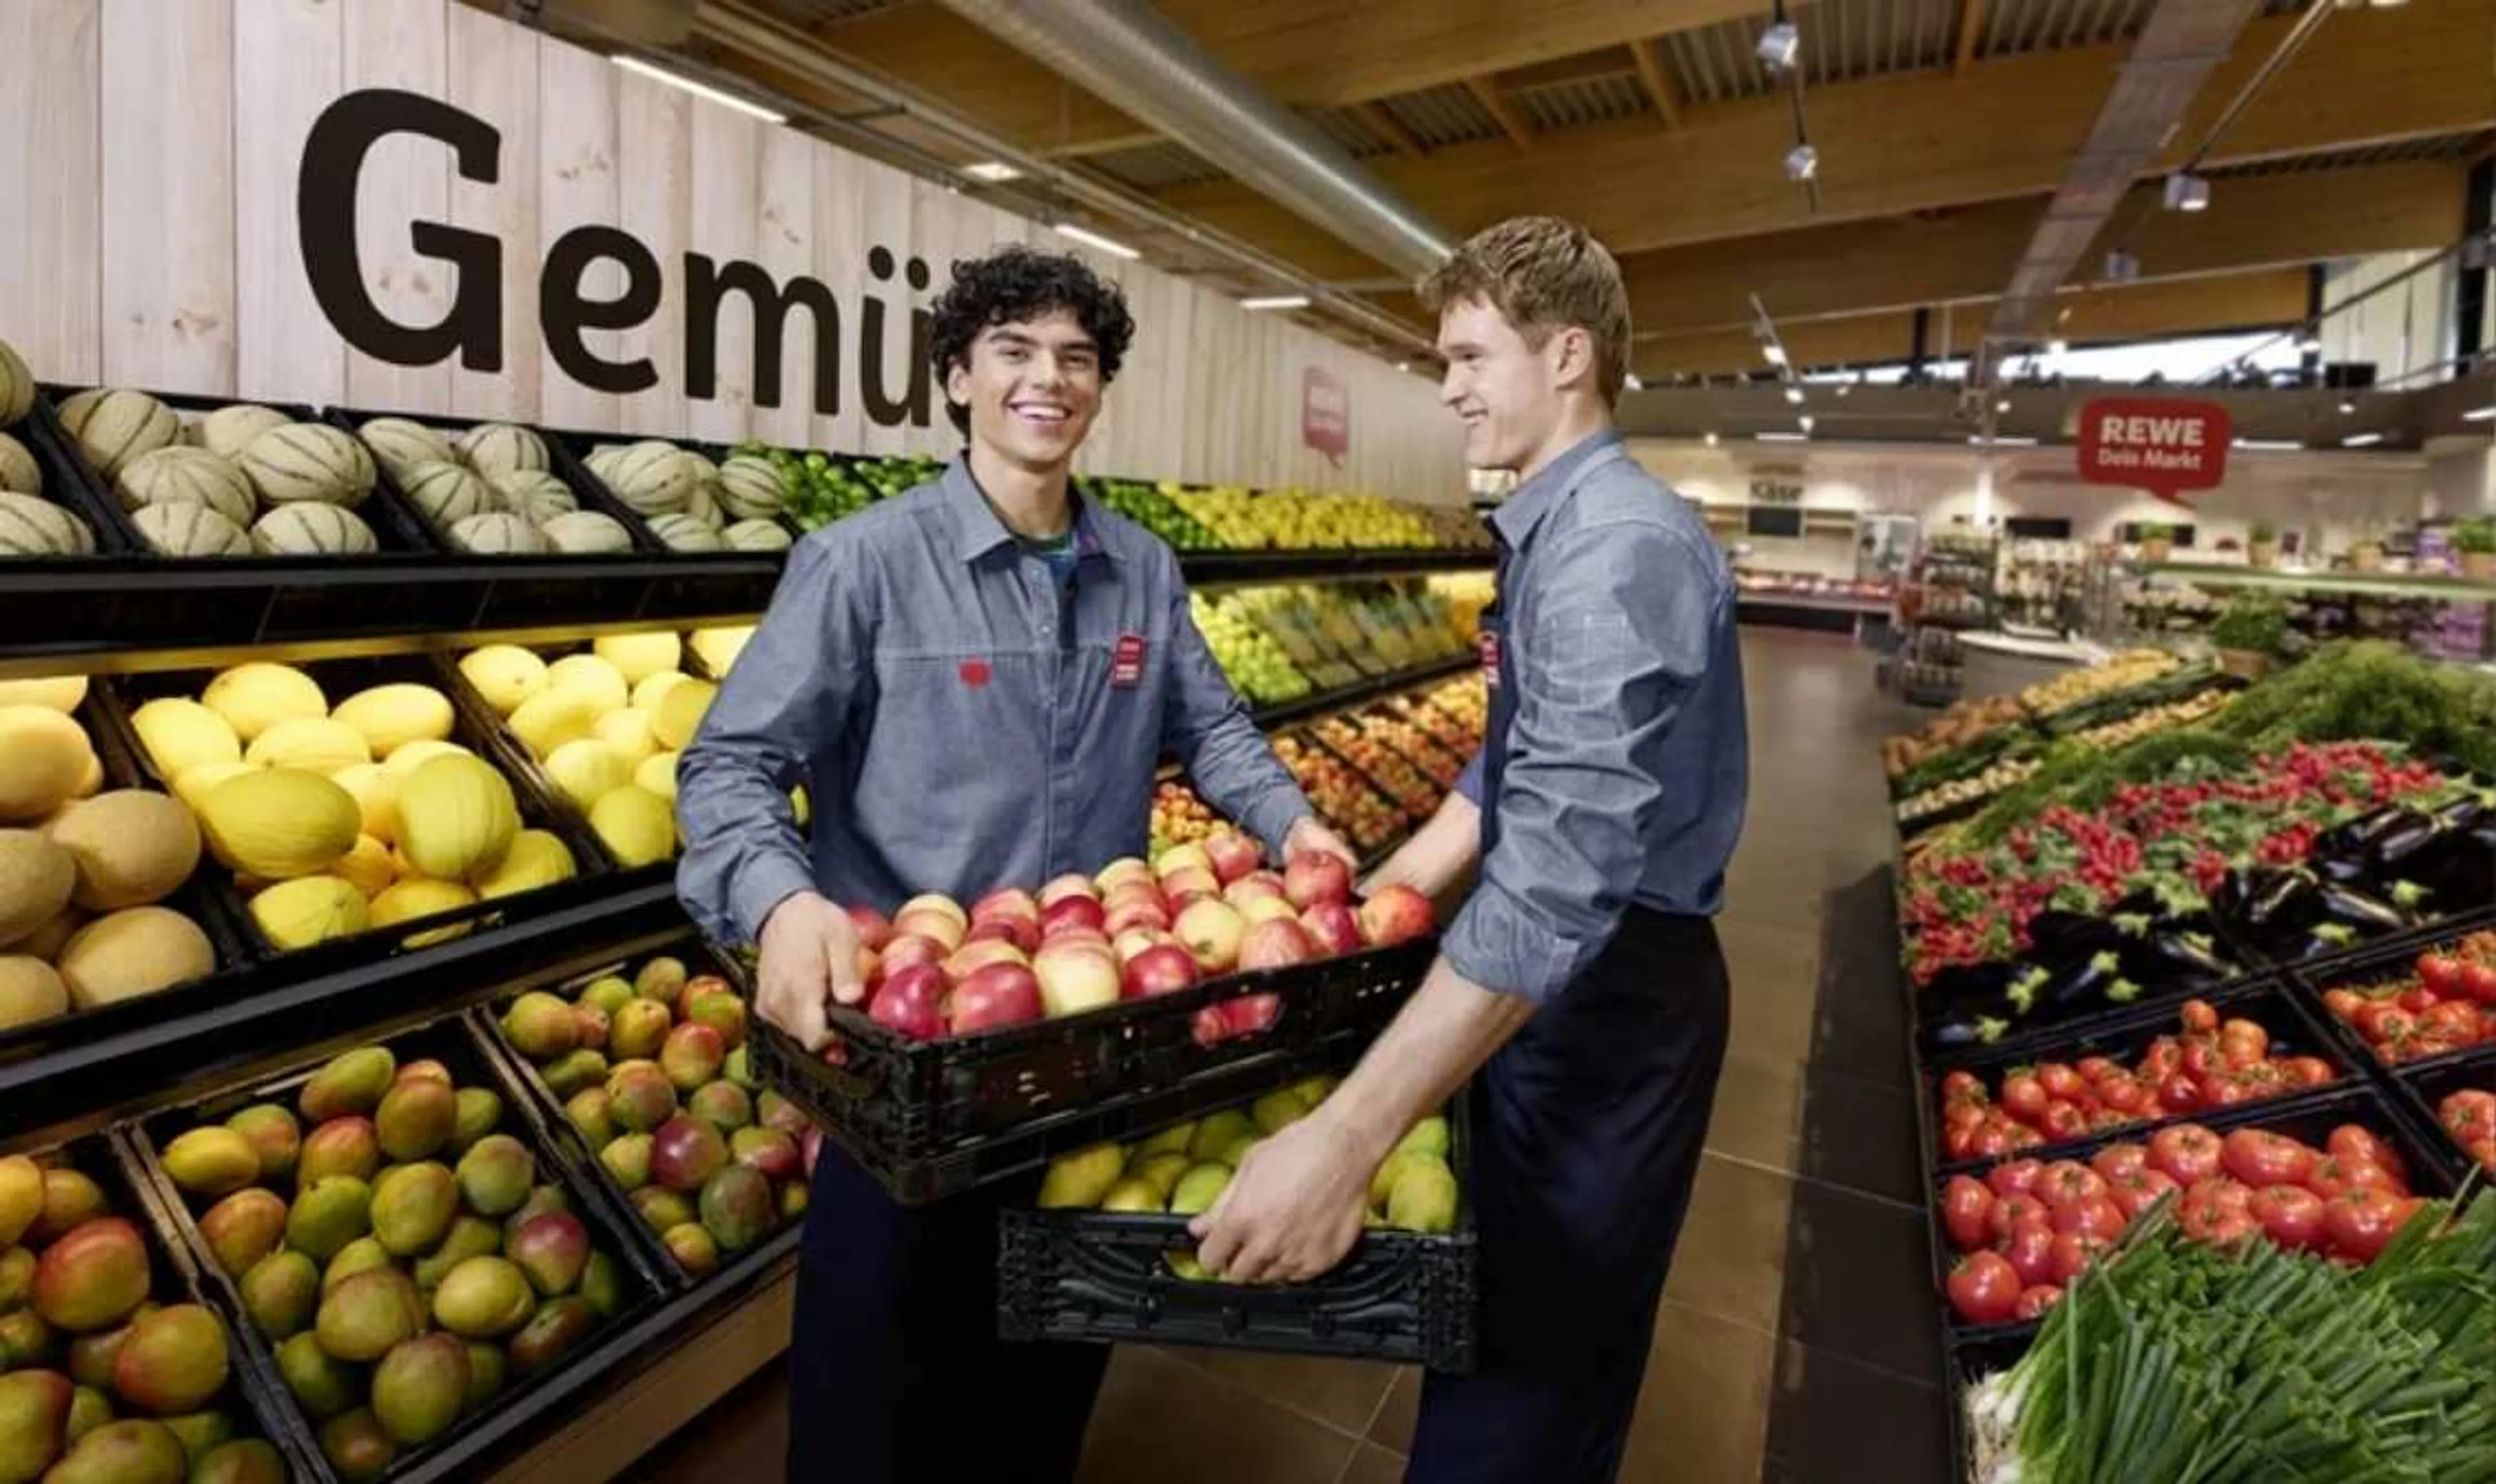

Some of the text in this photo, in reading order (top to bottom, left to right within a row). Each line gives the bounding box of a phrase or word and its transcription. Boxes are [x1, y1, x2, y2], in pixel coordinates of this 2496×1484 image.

[298, 88, 970, 439] Gemü
[2100, 415, 2205, 447] REWE
[2097, 447, 2202, 471] Dein Markt
